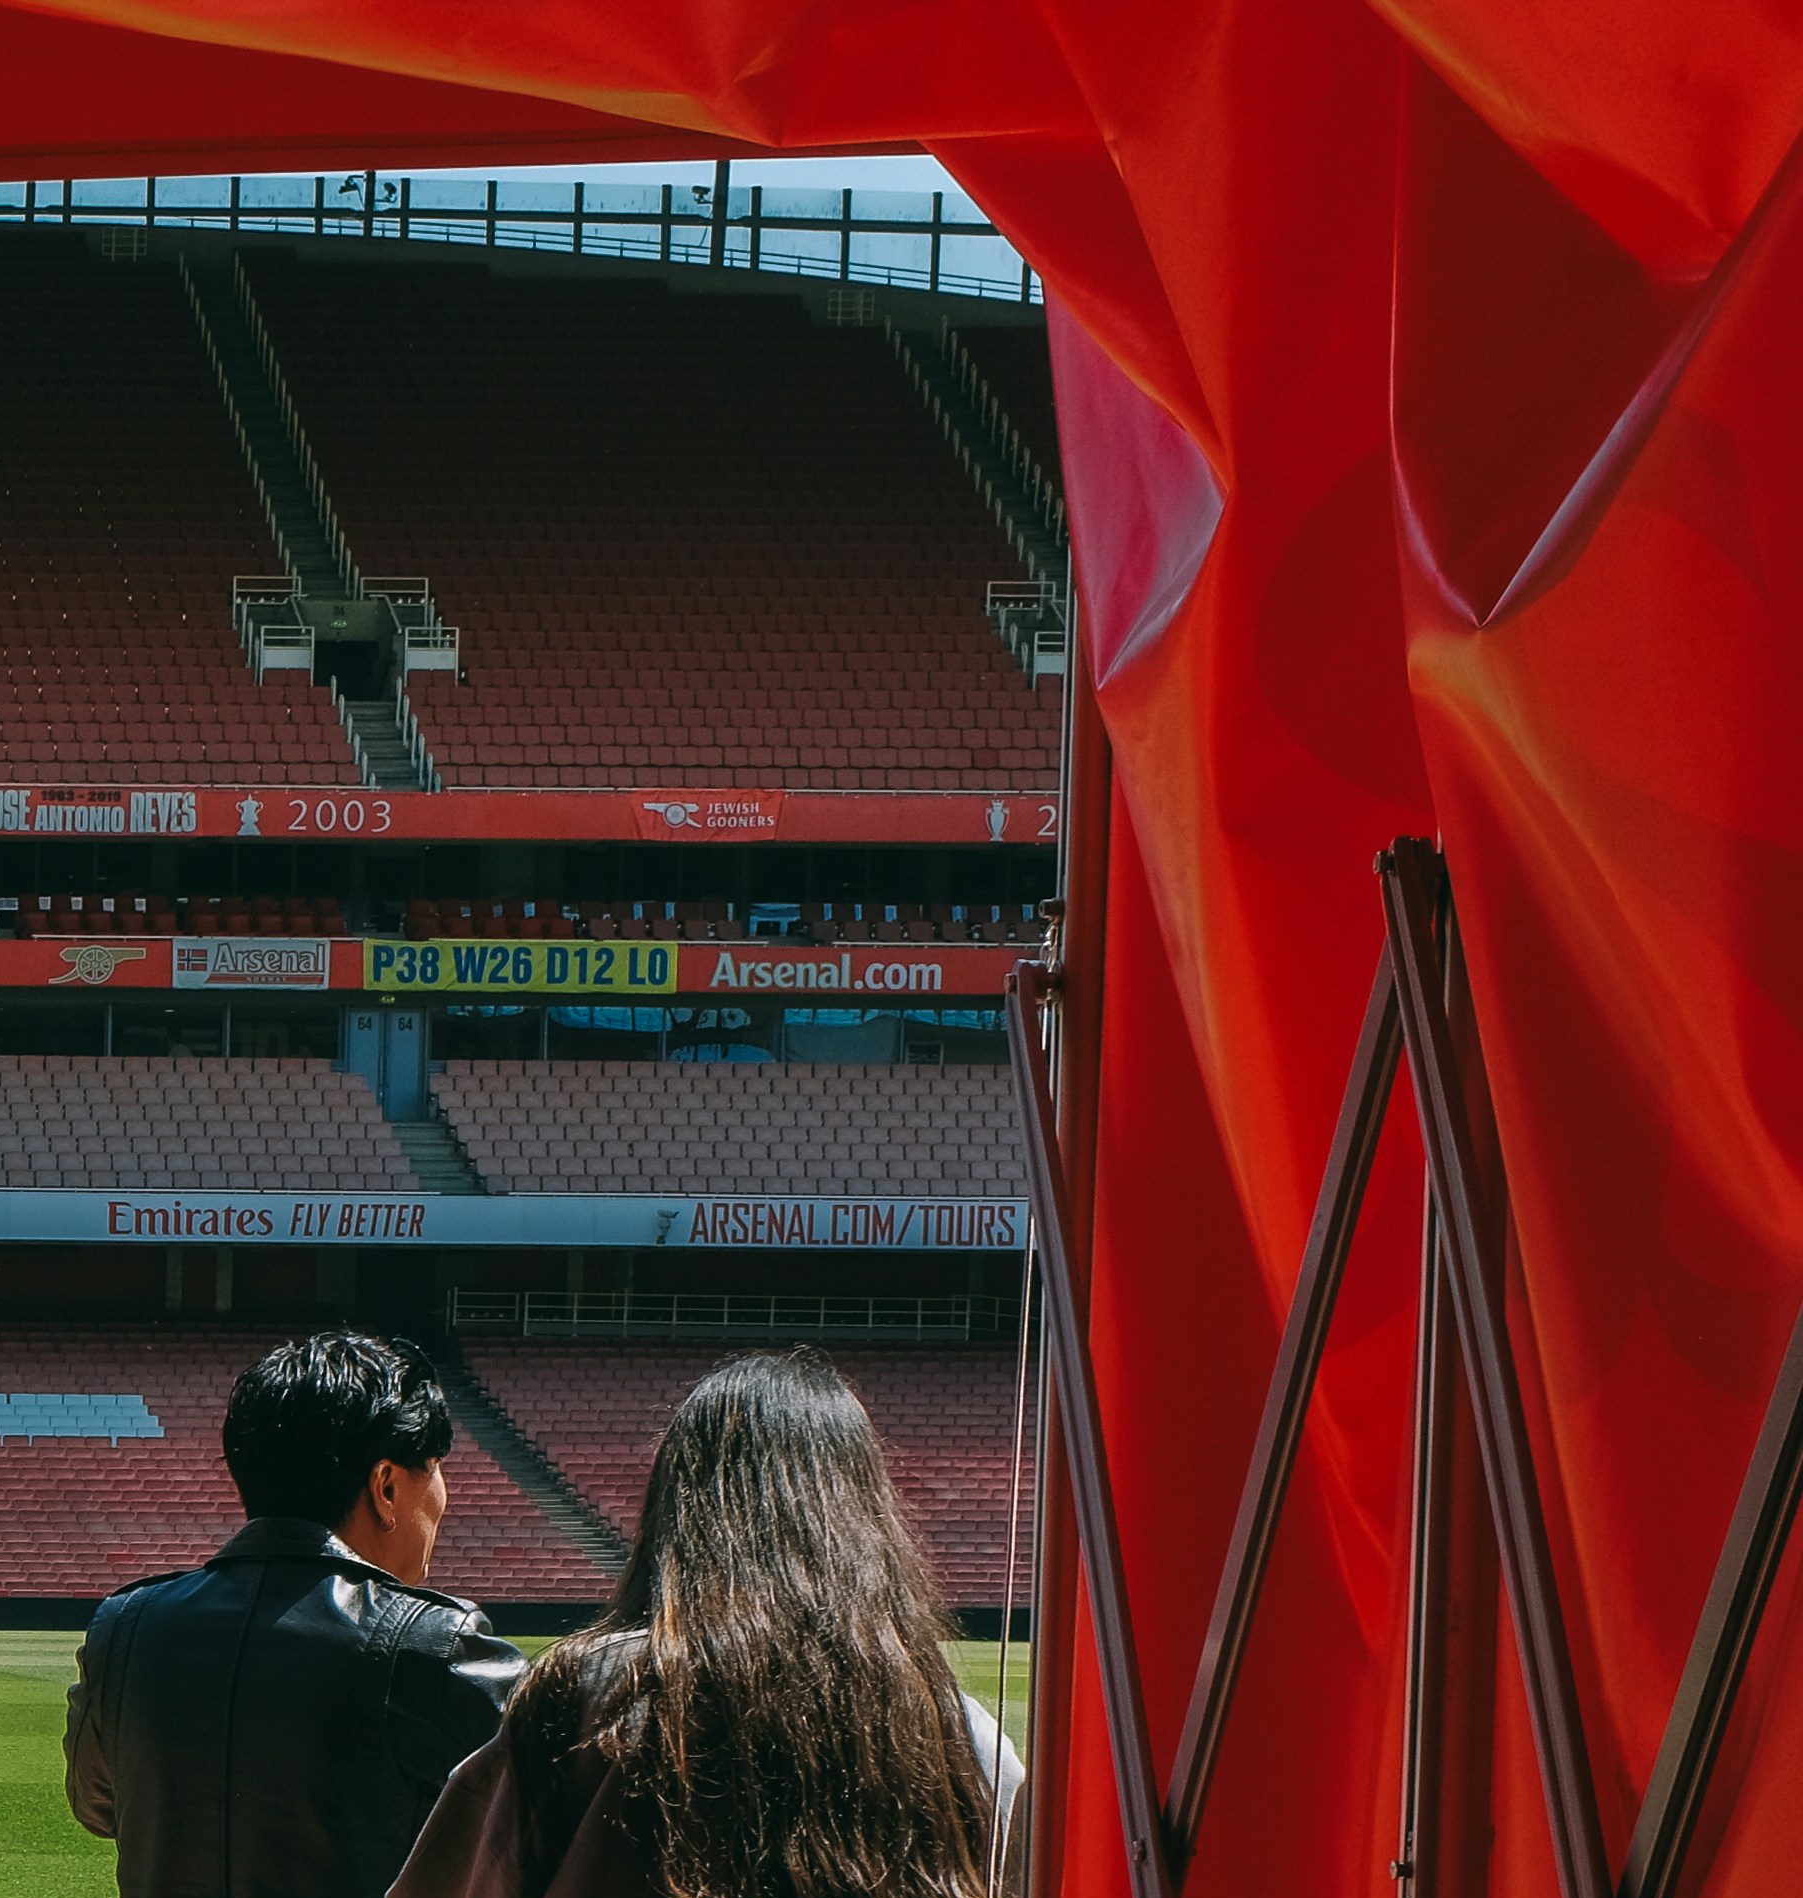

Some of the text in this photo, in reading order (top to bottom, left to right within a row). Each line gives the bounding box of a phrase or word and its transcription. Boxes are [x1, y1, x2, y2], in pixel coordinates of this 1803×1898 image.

[34, 805, 125, 832] ANTONIO
[129, 791, 197, 833] REYES
[288, 799, 392, 832] 2003
[706, 802, 760, 815] JEWISH
[706, 815, 775, 829] GOONERS
[213, 942, 325, 973] Arsenal
[371, 946, 441, 985] P38
[453, 946, 533, 985] W26
[547, 946, 614, 986] D12
[709, 951, 943, 991] Arsenal.com
[357, 1016, 373, 1031] 64
[397, 1016, 413, 1031] 64
[106, 1200, 426, 1238] Emirates FLY BETTER
[688, 1203, 1016, 1248] ARSENAL.COM/TOURS
